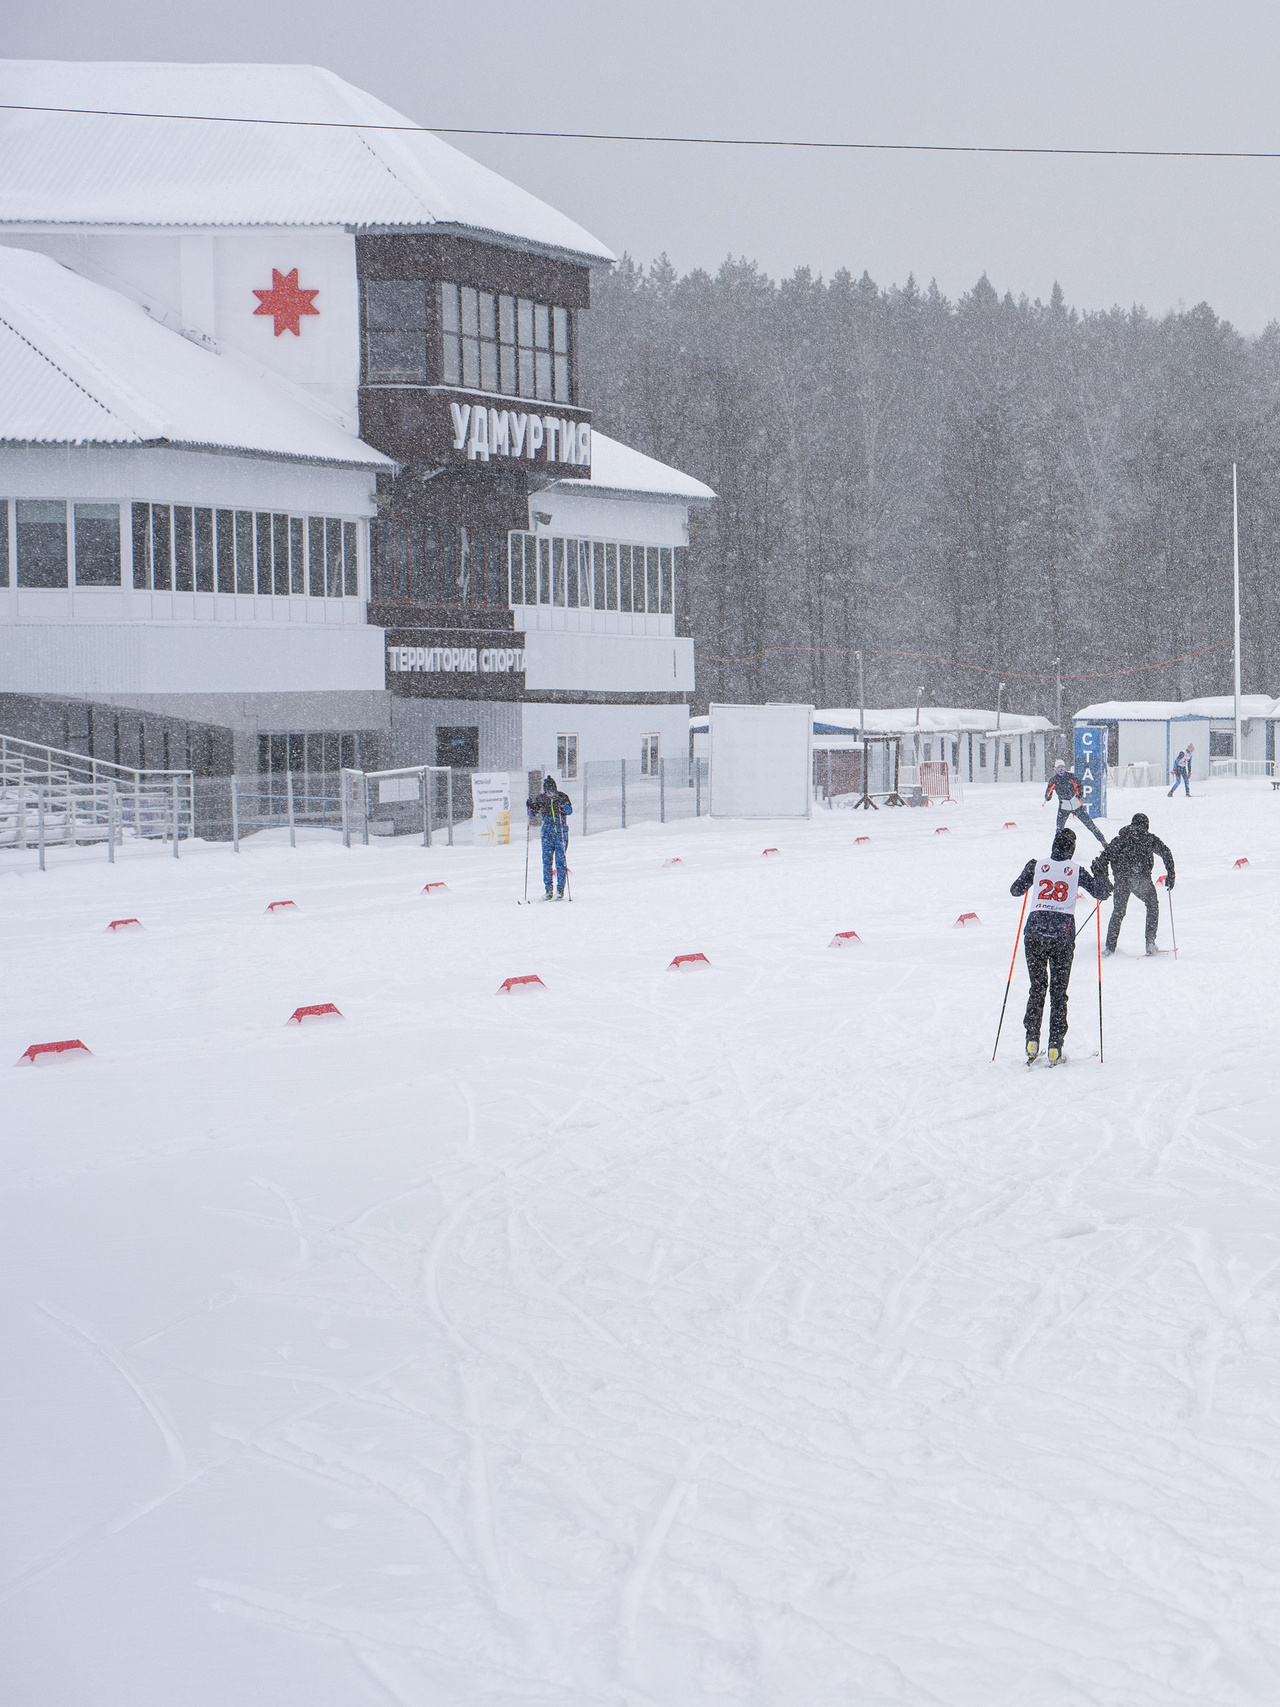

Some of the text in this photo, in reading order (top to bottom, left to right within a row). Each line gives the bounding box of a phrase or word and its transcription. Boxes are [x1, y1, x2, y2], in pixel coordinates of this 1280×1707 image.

[450, 402, 591, 466] УДМУРТИЯ
[388, 646, 528, 672] ТЕРРИТОРИЯ СПОРТА
[1082, 732, 1094, 815] СТАРТ
[1038, 878, 1069, 902] 28
